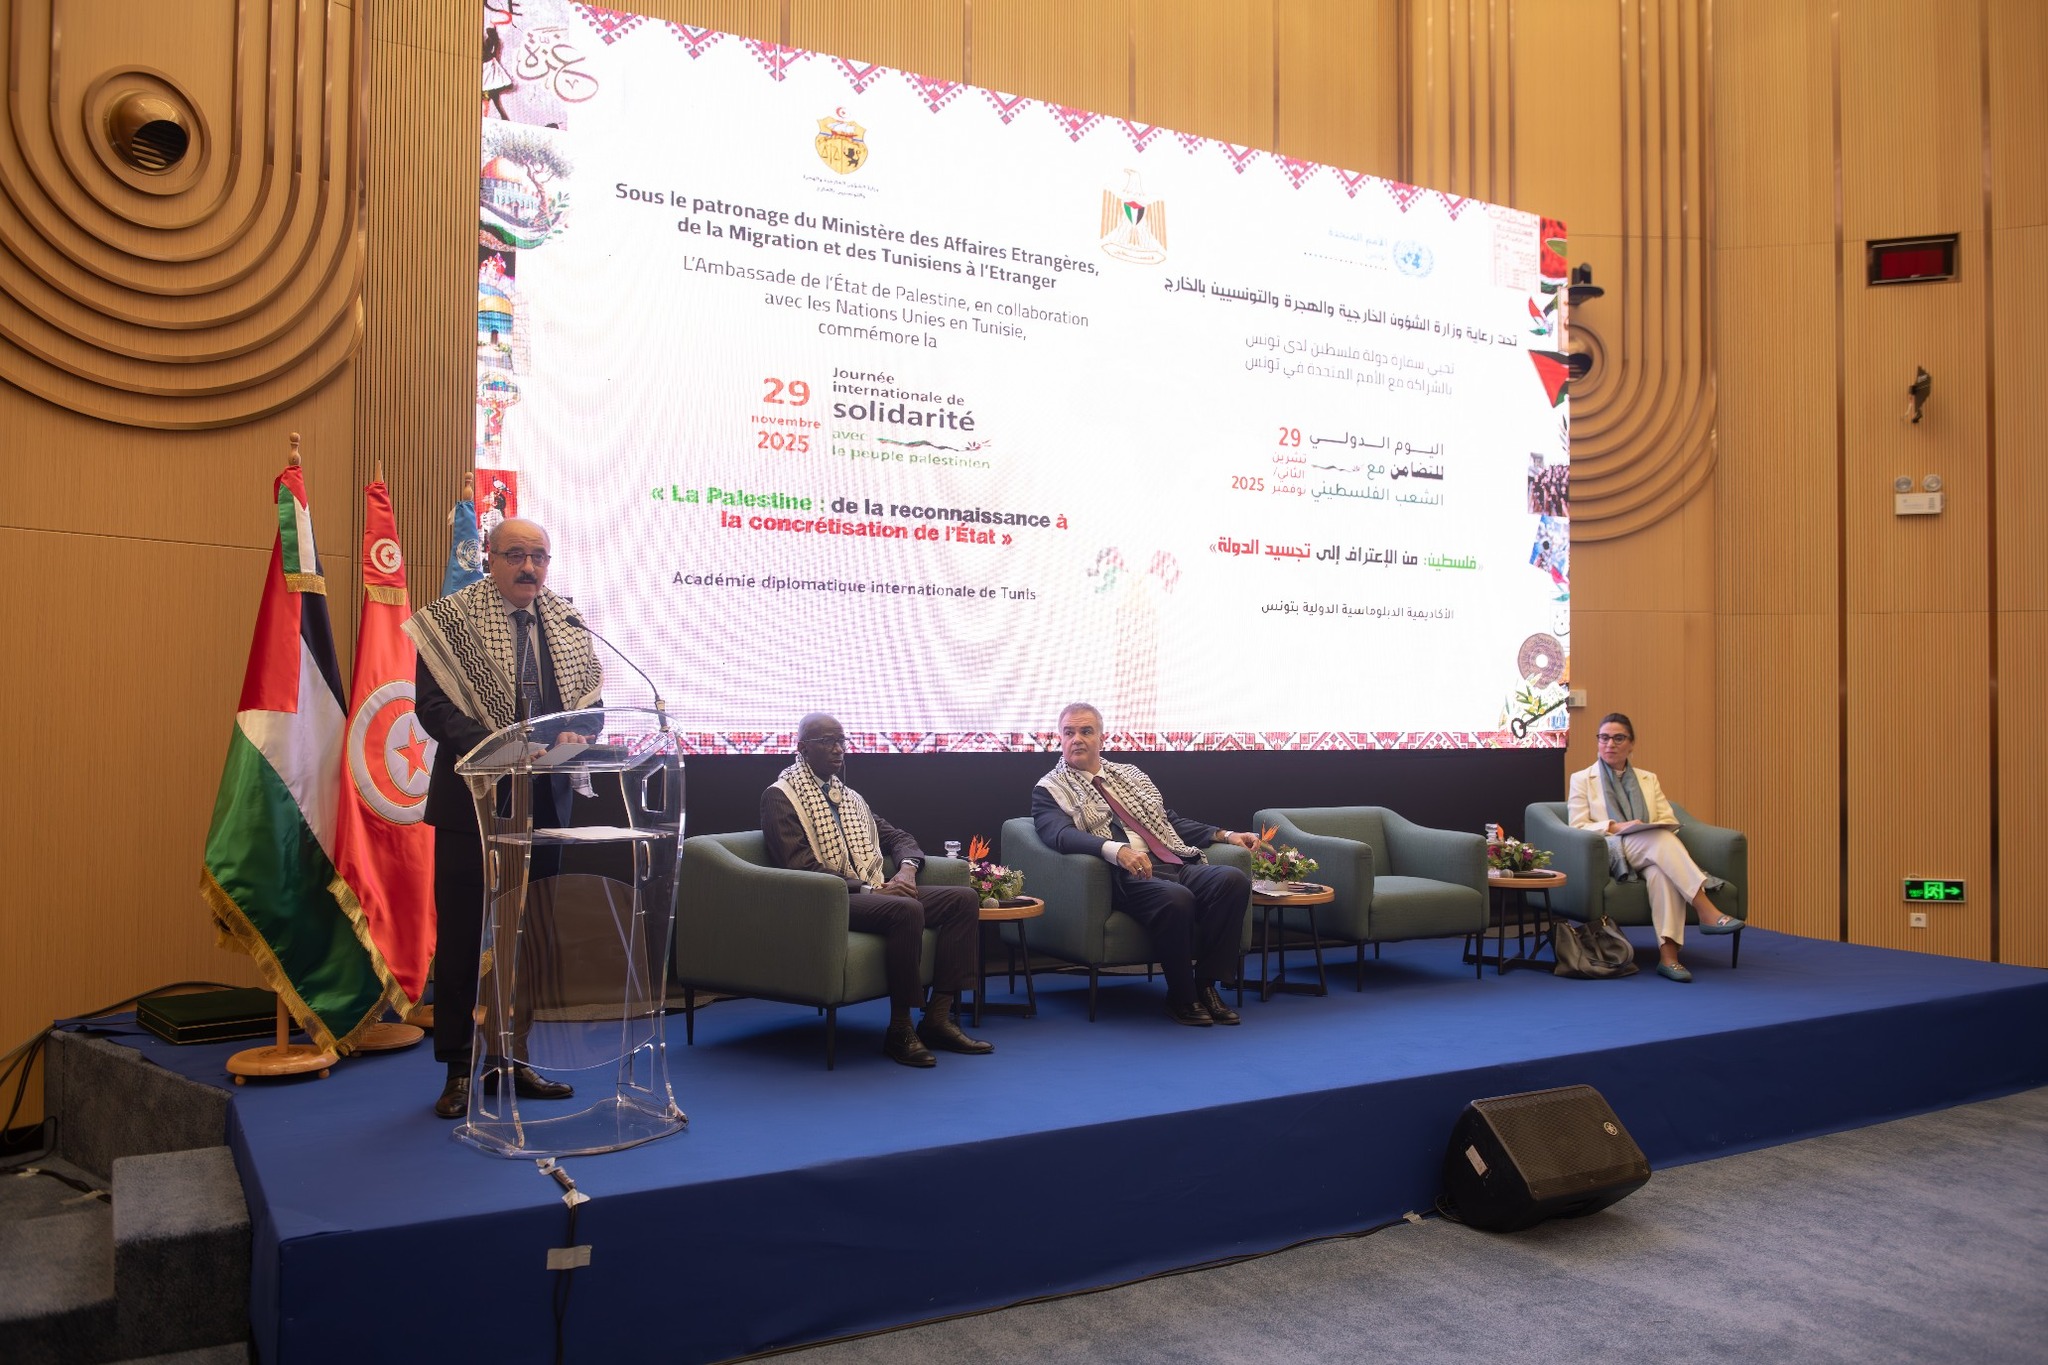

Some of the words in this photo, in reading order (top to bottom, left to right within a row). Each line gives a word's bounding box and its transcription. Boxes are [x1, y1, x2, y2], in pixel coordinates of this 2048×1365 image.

[616, 183, 664, 204] Sous
[670, 190, 686, 208] le
[693, 198, 789, 226] patronage
[794, 212, 816, 228] du
[822, 216, 904, 242] Ministère
[910, 230, 939, 248] des
[944, 236, 1006, 260] Affaires
[1012, 247, 1099, 276] Etrangères,
[678, 217, 700, 234] de
[706, 220, 723, 238] la
[730, 224, 818, 252] Migration
[823, 241, 841, 256] et
[846, 243, 876, 261] des
[882, 248, 962, 274] Tunisiens
[966, 261, 975, 276] à
[980, 263, 1056, 290] l'Etranger
[684, 255, 796, 286] L'Ambassade
[801, 269, 820, 289] de
[826, 273, 868, 296] l'État
[872, 283, 891, 298] de
[896, 286, 970, 312] Palestine,
[974, 300, 992, 314] en
[996, 302, 1088, 326] collaboration
[1164, 276, 1206, 298] بالخارج
[1211, 282, 1279, 308] والتونسيين
[1284, 294, 1334, 318] والهجرة
[1339, 304, 1386, 324] الخارجية
[764, 292, 802, 309] avec
[808, 294, 830, 312] les
[836, 299, 898, 322] Nations
[902, 308, 946, 328] Unies
[949, 318, 968, 330] en
[972, 318, 1027, 342] Tunisie,
[1390, 312, 1430, 331] الشؤون
[818, 322, 920, 346] commémore
[924, 332, 938, 348] la
[1434, 320, 1462, 339] وزارة
[1466, 326, 1494, 345] رعاية
[1246, 333, 1280, 351] تونس
[1284, 339, 1306, 354] لدى
[1311, 342, 1360, 360] فلسطين
[1246, 356, 1280, 373] تونس
[1363, 348, 1388, 366] دولة
[1391, 354, 1424, 370] سفارة
[832, 367, 894, 384] Journée
[1284, 362, 1304, 378] في
[1307, 363, 1352, 380] المتحدة
[1356, 369, 1384, 386] الأمم
[763, 378, 810, 406] 29
[832, 381, 942, 404] internationale
[946, 394, 965, 406] de
[1388, 378, 1404, 392] مع
[751, 414, 821, 429] novembre
[833, 400, 976, 432] solidarité
[758, 430, 810, 454] 2025
[832, 430, 867, 442] avec
[1278, 426, 1301, 448] 29
[832, 445, 846, 457] le
[850, 448, 904, 462] peuple
[909, 452, 990, 470] palestinien
[1272, 451, 1306, 464] تشرين
[1367, 464, 1385, 480] مع
[1390, 461, 1444, 480] للتضامن
[1232, 476, 1264, 492] 2025
[1272, 484, 1306, 496] نوفمبر
[1311, 480, 1389, 502] الفلسطيني
[652, 487, 664, 500] «
[672, 484, 699, 504] La
[706, 486, 812, 511] Palestine
[820, 498, 825, 512] :
[831, 497, 858, 514] de
[864, 498, 883, 516] la
[890, 504, 1050, 528] reconnaissance
[1056, 514, 1068, 530] à
[1396, 489, 1444, 506] الشعب
[721, 510, 742, 528] la
[750, 516, 908, 539] concrétisation
[914, 524, 939, 541] de
[945, 522, 996, 545] l'État
[1002, 533, 1012, 546] »
[1265, 543, 1310, 562] تجسيد
[1316, 544, 1340, 565] إلى
[1344, 546, 1397, 568] الإعتراف
[1402, 550, 1418, 566] من
[672, 571, 756, 588] Académie
[762, 576, 866, 594] diplomatique
[870, 581, 975, 598] internationale
[979, 586, 996, 599] de
[1000, 587, 1036, 600] Tunis
[1261, 600, 1299, 616] بتونس
[1302, 600, 1338, 616] الدولية
[1342, 602, 1404, 618] الدبلوماسية
[1407, 606, 1454, 620] الأكاديمية
